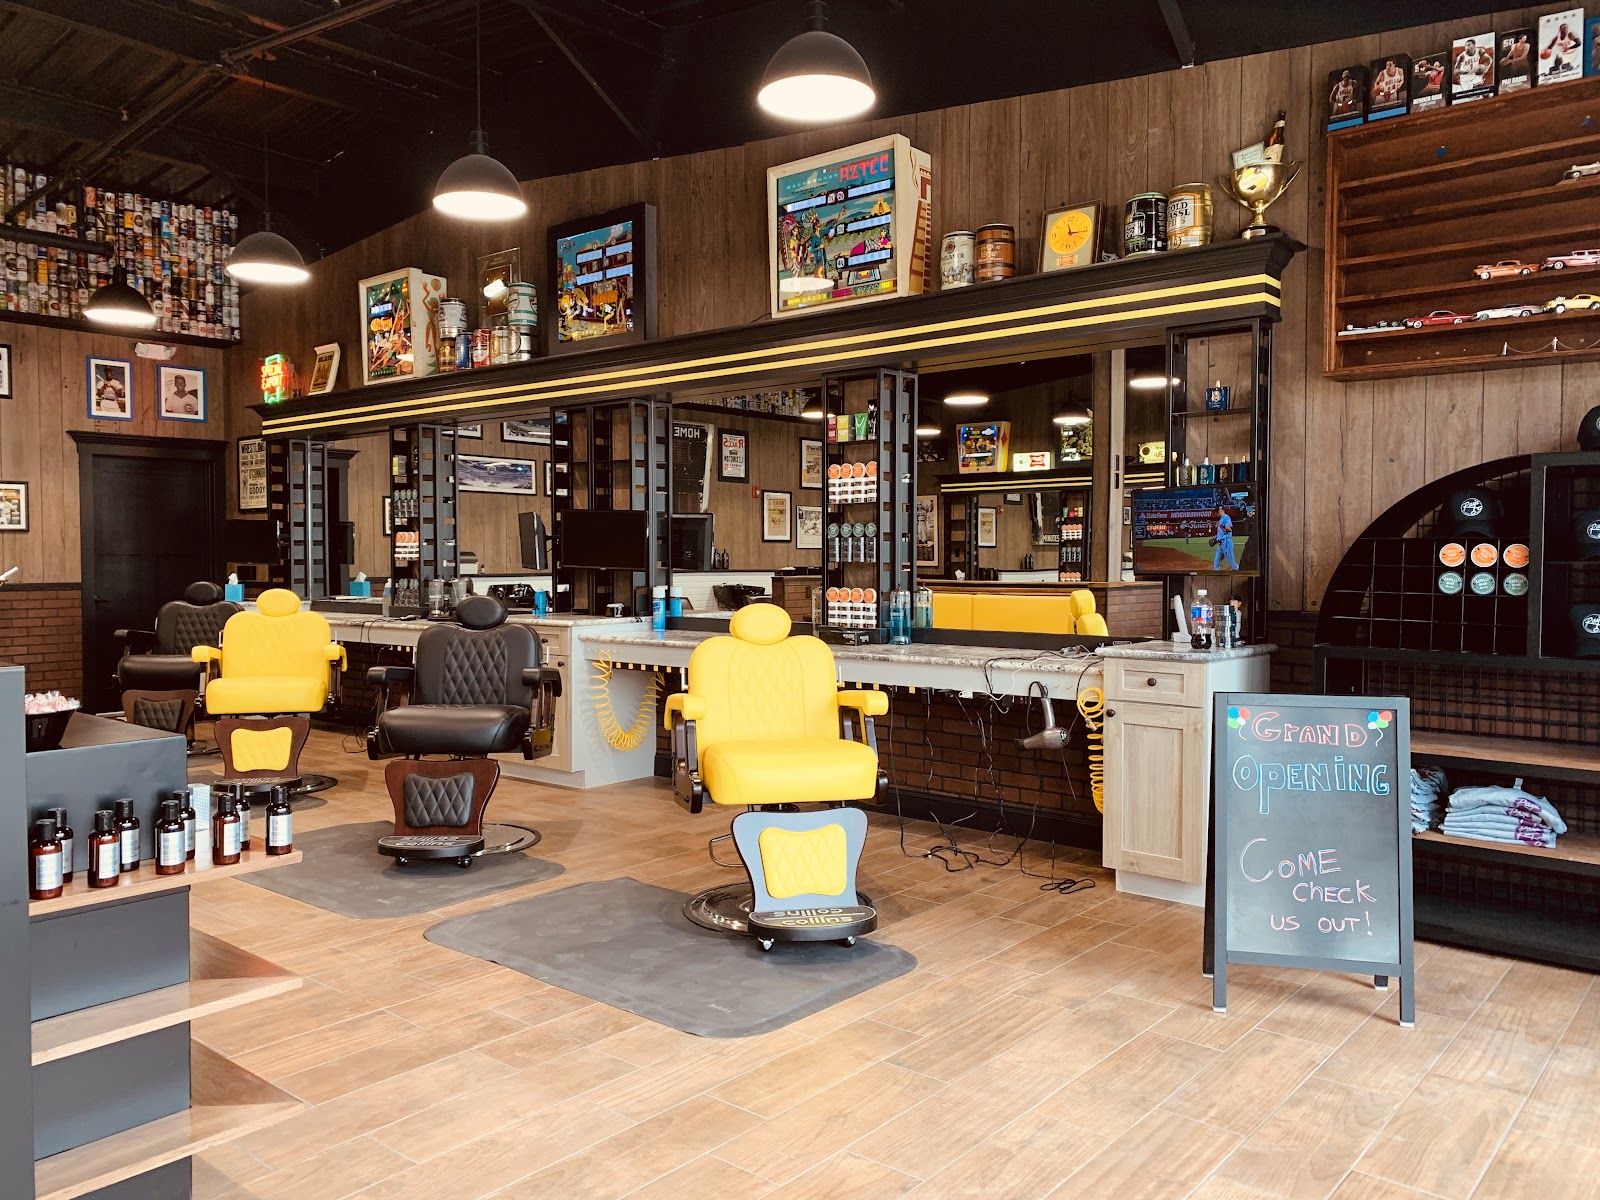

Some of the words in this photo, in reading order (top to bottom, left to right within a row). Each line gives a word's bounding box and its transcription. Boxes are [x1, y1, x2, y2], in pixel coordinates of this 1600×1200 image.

[839, 153, 889, 183] AZTEC
[1168, 201, 1188, 212] OLD
[1171, 510, 1212, 518] NEIGHBORHOOD
[1239, 837, 1342, 883] COME
[781, 915, 854, 926] collins
[1270, 913, 1300, 931] US
[1317, 910, 1374, 937] OUT!
